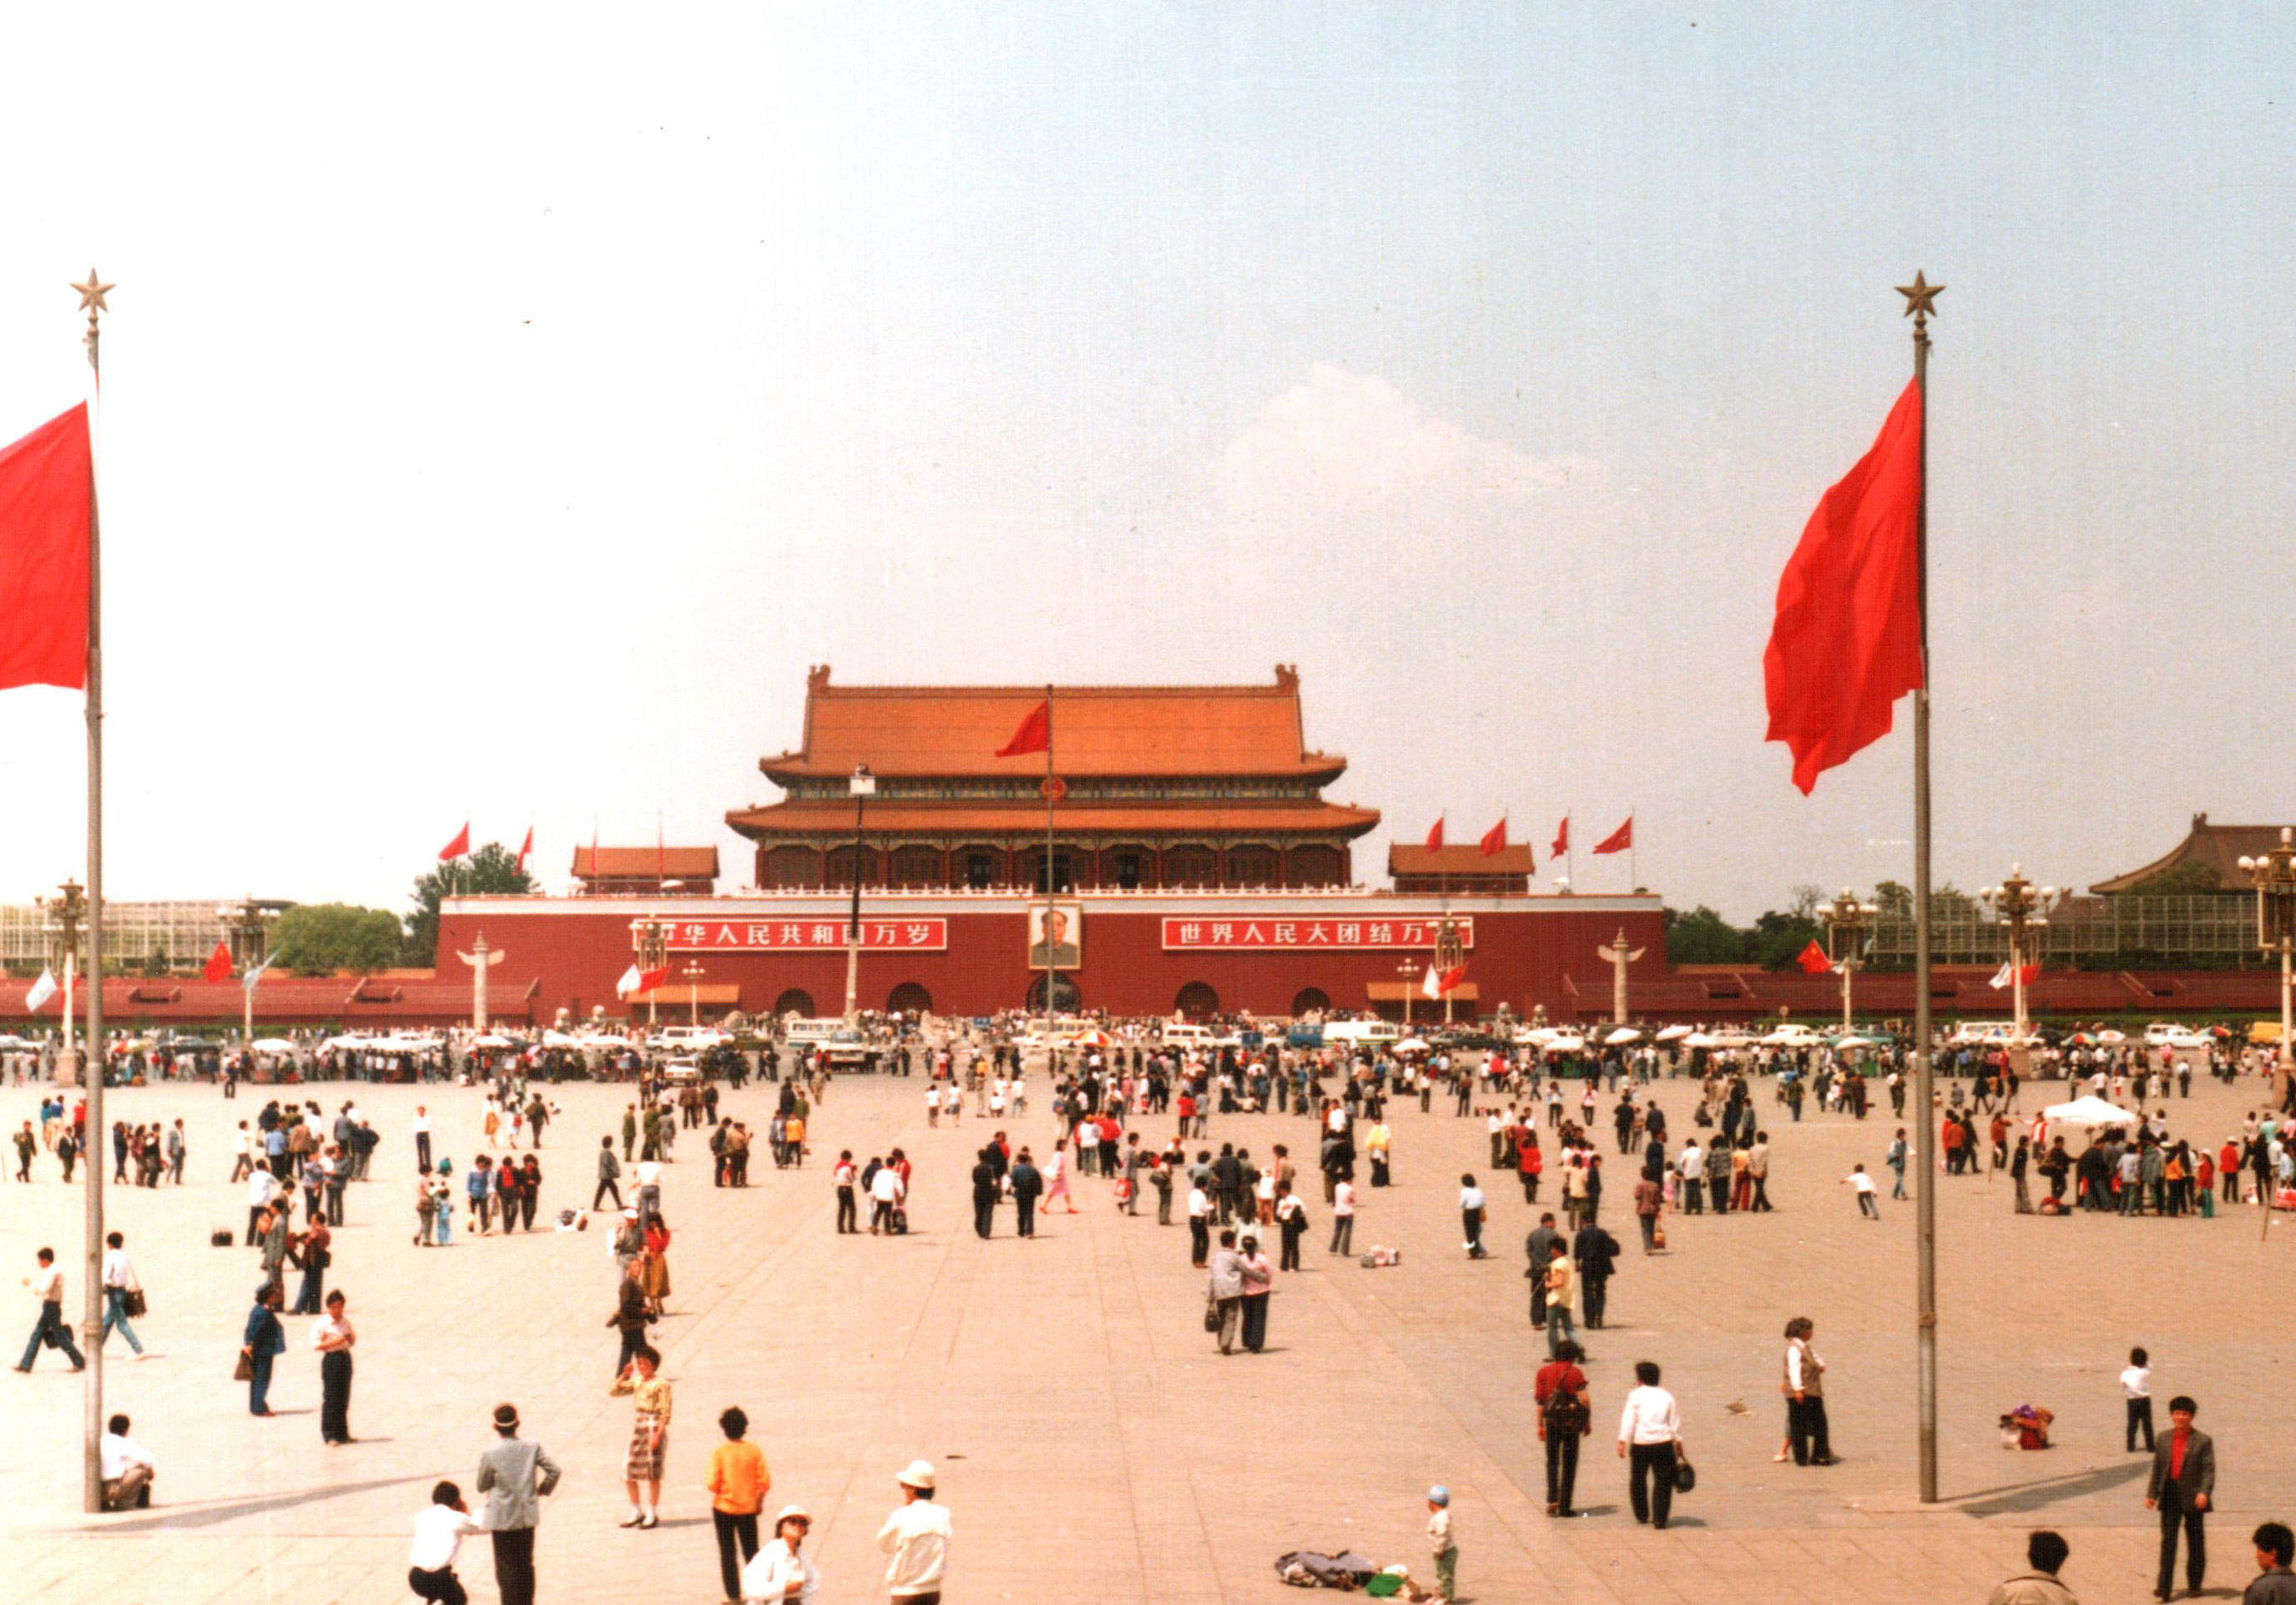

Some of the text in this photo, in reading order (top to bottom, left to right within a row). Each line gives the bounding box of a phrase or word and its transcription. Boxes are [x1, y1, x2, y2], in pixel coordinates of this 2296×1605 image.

[1180, 923, 1444, 944] 世界人民大团结万
